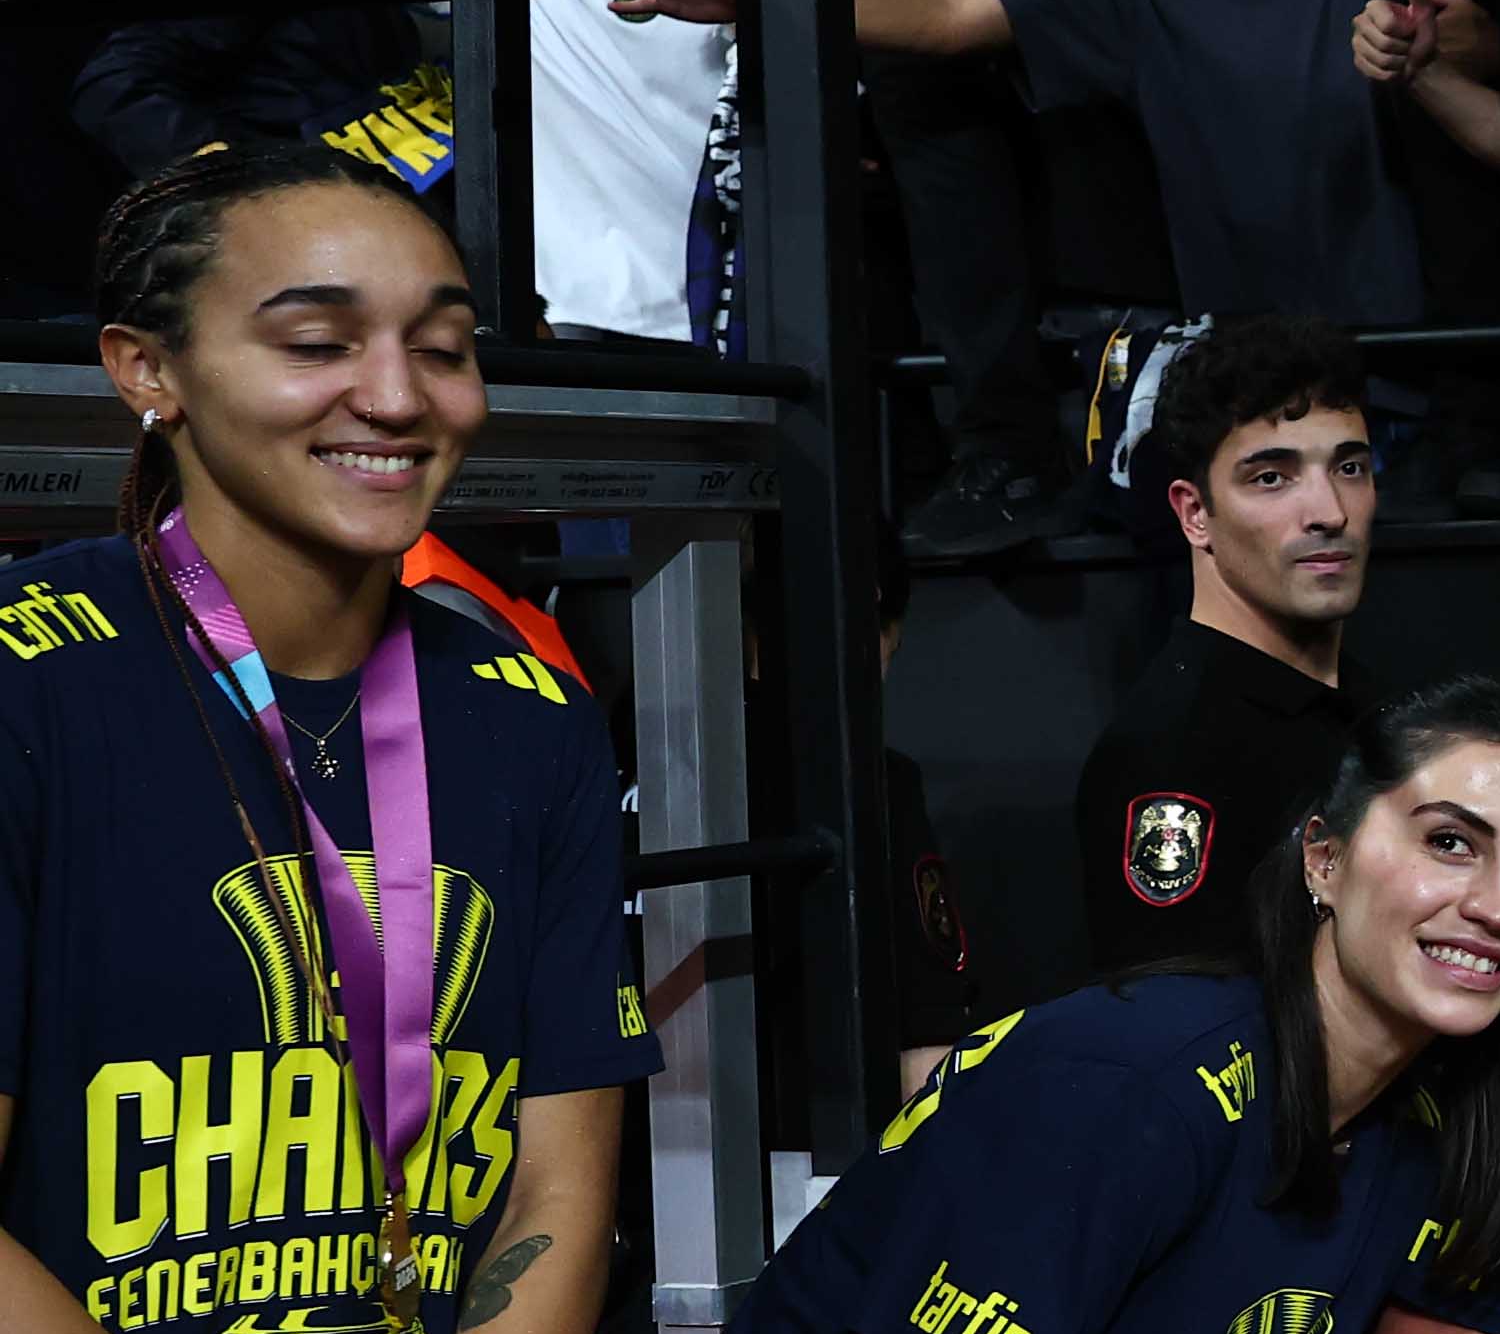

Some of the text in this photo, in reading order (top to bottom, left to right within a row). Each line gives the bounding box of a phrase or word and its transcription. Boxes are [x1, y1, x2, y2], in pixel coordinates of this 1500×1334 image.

[0, 470, 82, 495] MLERİ
[616, 983, 649, 1039] tar
[86, 1233, 380, 1332] FENERBAHÇ
